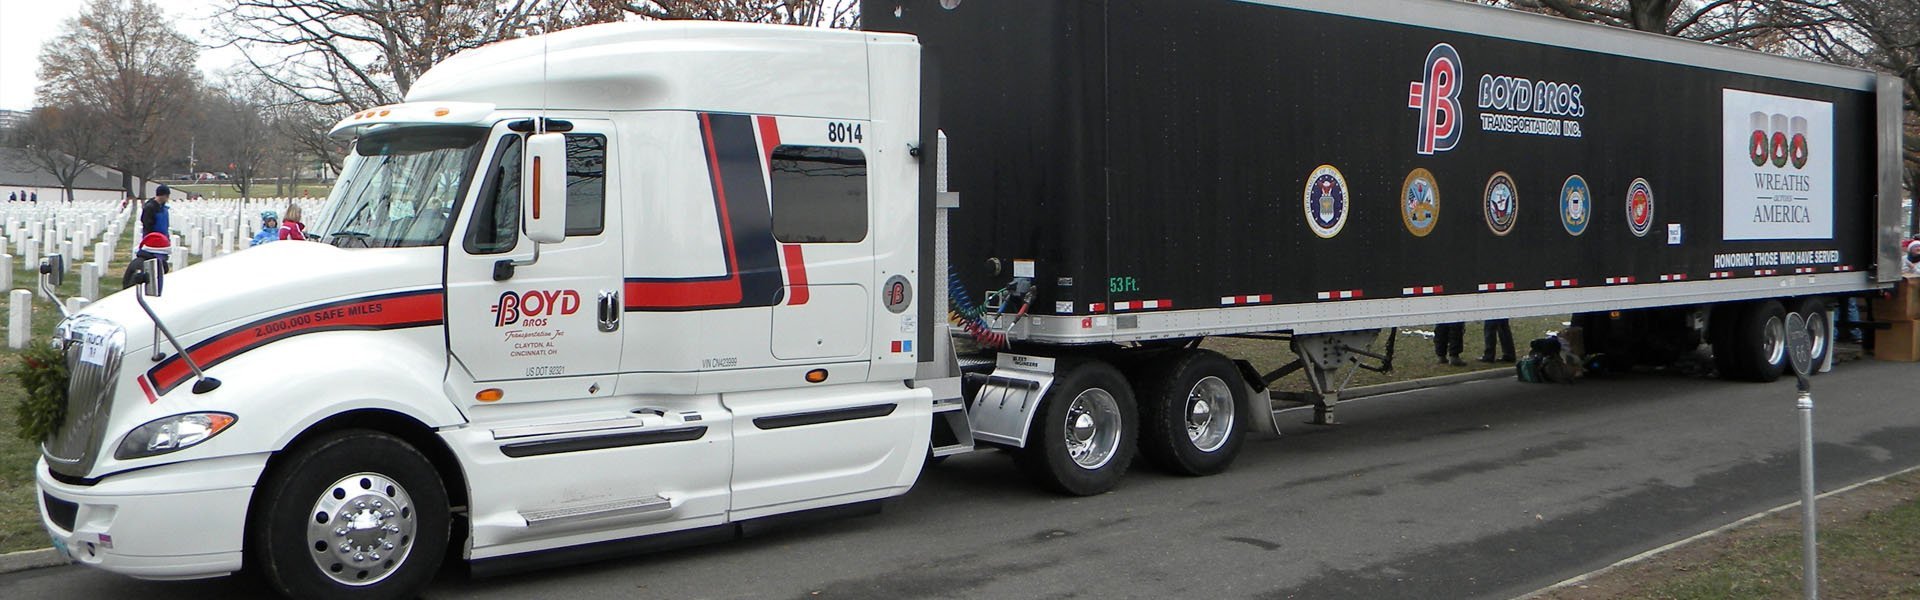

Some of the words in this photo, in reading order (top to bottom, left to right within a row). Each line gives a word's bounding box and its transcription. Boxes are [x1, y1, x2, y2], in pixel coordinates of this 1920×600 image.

[1478, 73, 1533, 112] BOYD
[1533, 80, 1585, 117] BROS.
[828, 121, 863, 144] 8014
[1480, 113, 1561, 136] TRANSPORTATION
[1563, 120, 1582, 137] INC.
[1754, 172, 1810, 192] WREATHS
[1753, 204, 1811, 223] AMERICA
[1714, 253, 1754, 269] HONORING
[1755, 251, 1779, 266] THOSE
[1779, 251, 1796, 265] WHO
[1796, 250, 1814, 264] HAVE
[1814, 250, 1840, 263] SERVED
[1110, 277, 1123, 293] 53
[1126, 276, 1140, 292] Ft.
[314, 308, 345, 322] SAFE
[348, 303, 383, 316] MILES
[493, 290, 581, 327] BOYD
[522, 318, 548, 327] BROS
[535, 366, 549, 376] DOT
